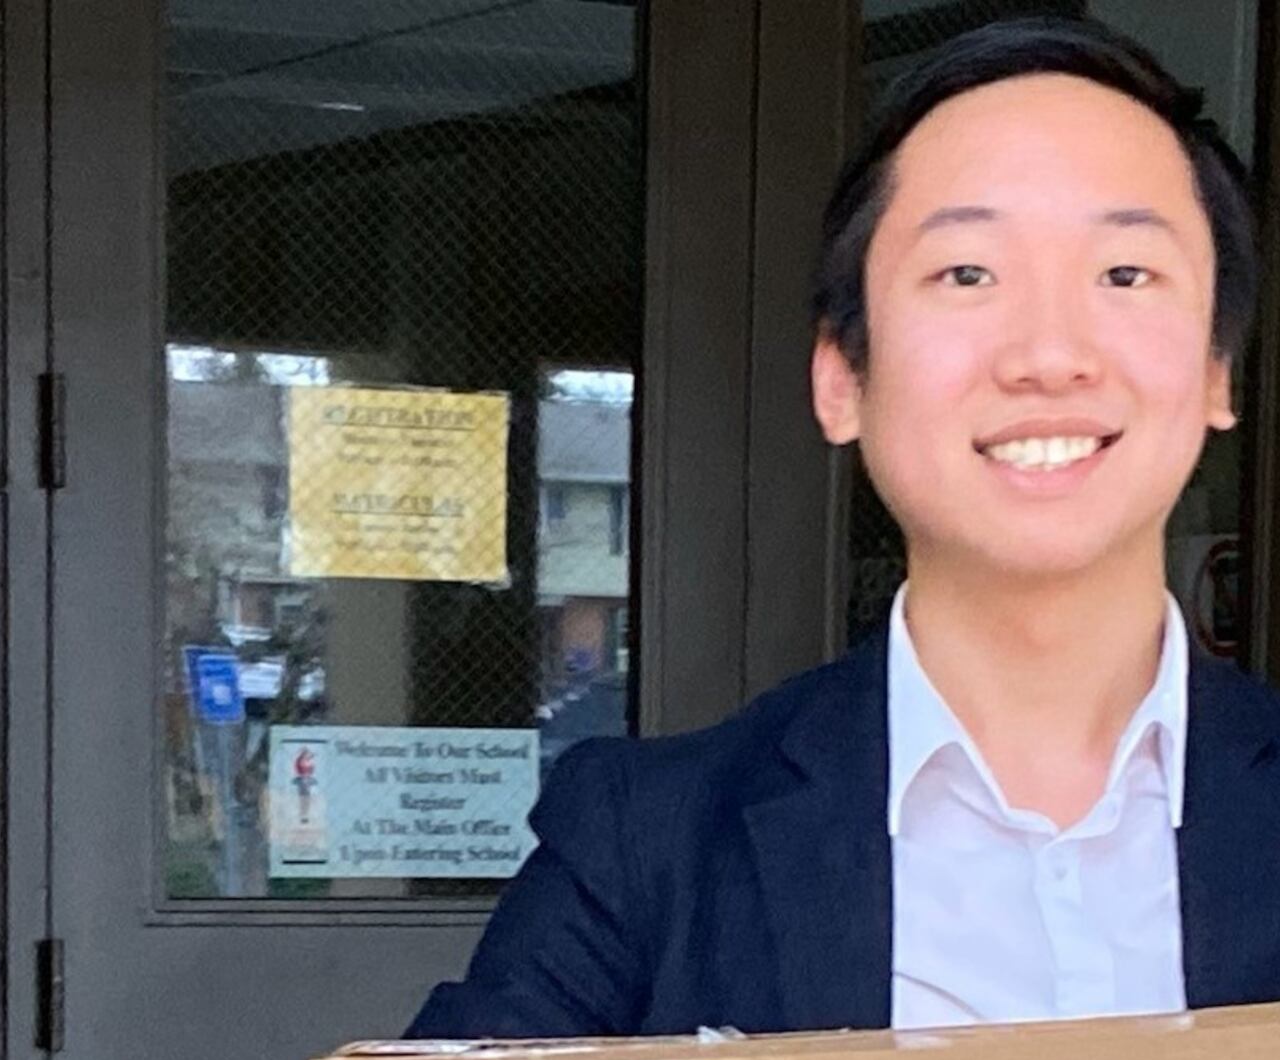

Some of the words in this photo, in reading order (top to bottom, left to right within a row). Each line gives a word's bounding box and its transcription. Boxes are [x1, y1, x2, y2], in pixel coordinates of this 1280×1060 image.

[335, 741, 407, 758] Welcome
[414, 742, 432, 759] To
[438, 743, 470, 759] Our
[476, 743, 530, 760] School
[366, 767, 388, 784] All
[393, 767, 454, 784] Visitors
[460, 768, 501, 785] Must
[400, 793, 466, 811] Register
[354, 819, 371, 835] At
[376, 819, 408, 835] The
[415, 819, 457, 835] Main
[461, 820, 511, 836] Office
[393, 846, 464, 864] Entering
[468, 846, 520, 861] School
